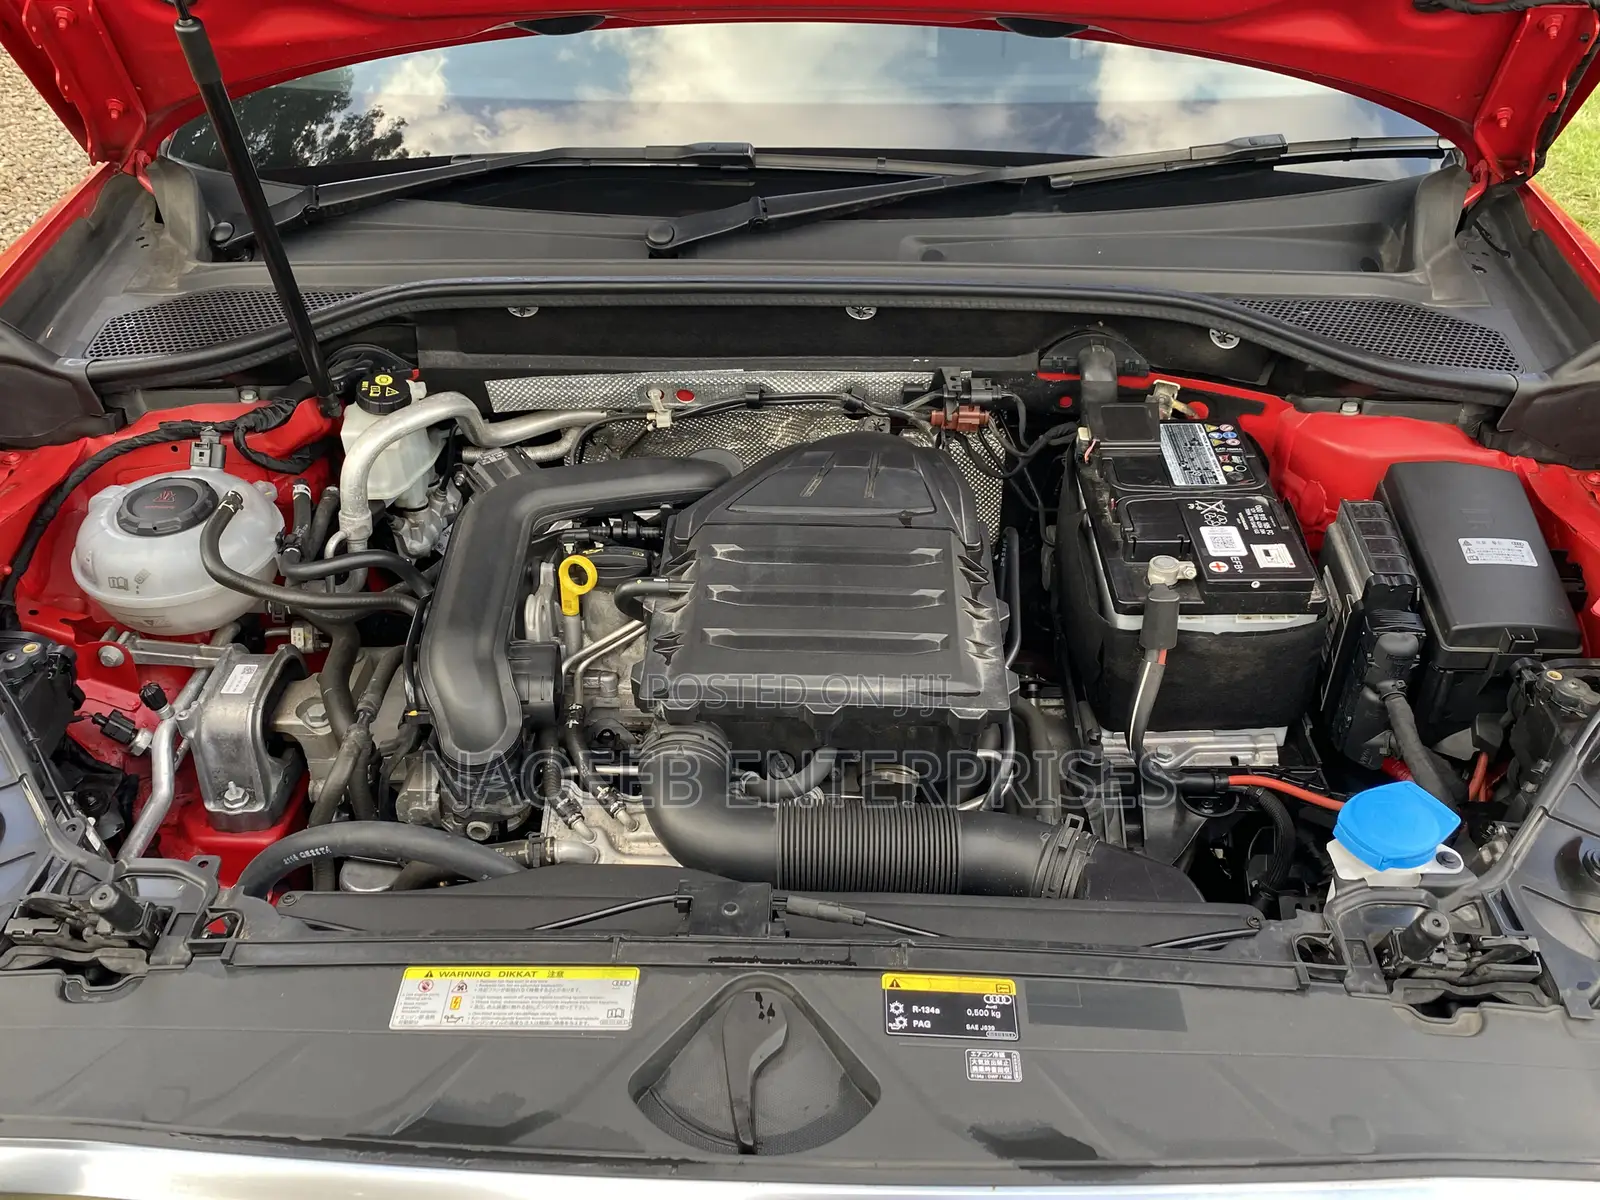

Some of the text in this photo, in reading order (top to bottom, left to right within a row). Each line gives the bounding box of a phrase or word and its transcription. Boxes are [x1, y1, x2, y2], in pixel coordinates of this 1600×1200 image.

[1230, 556, 1243, 573] EFB+
[439, 970, 538, 978] WARNING DIKKAT
[912, 1005, 941, 1015] R-134a
[966, 1008, 1001, 1019] 0,500 kg
[913, 1020, 932, 1028] PAG
[966, 1023, 979, 1031] SAE
